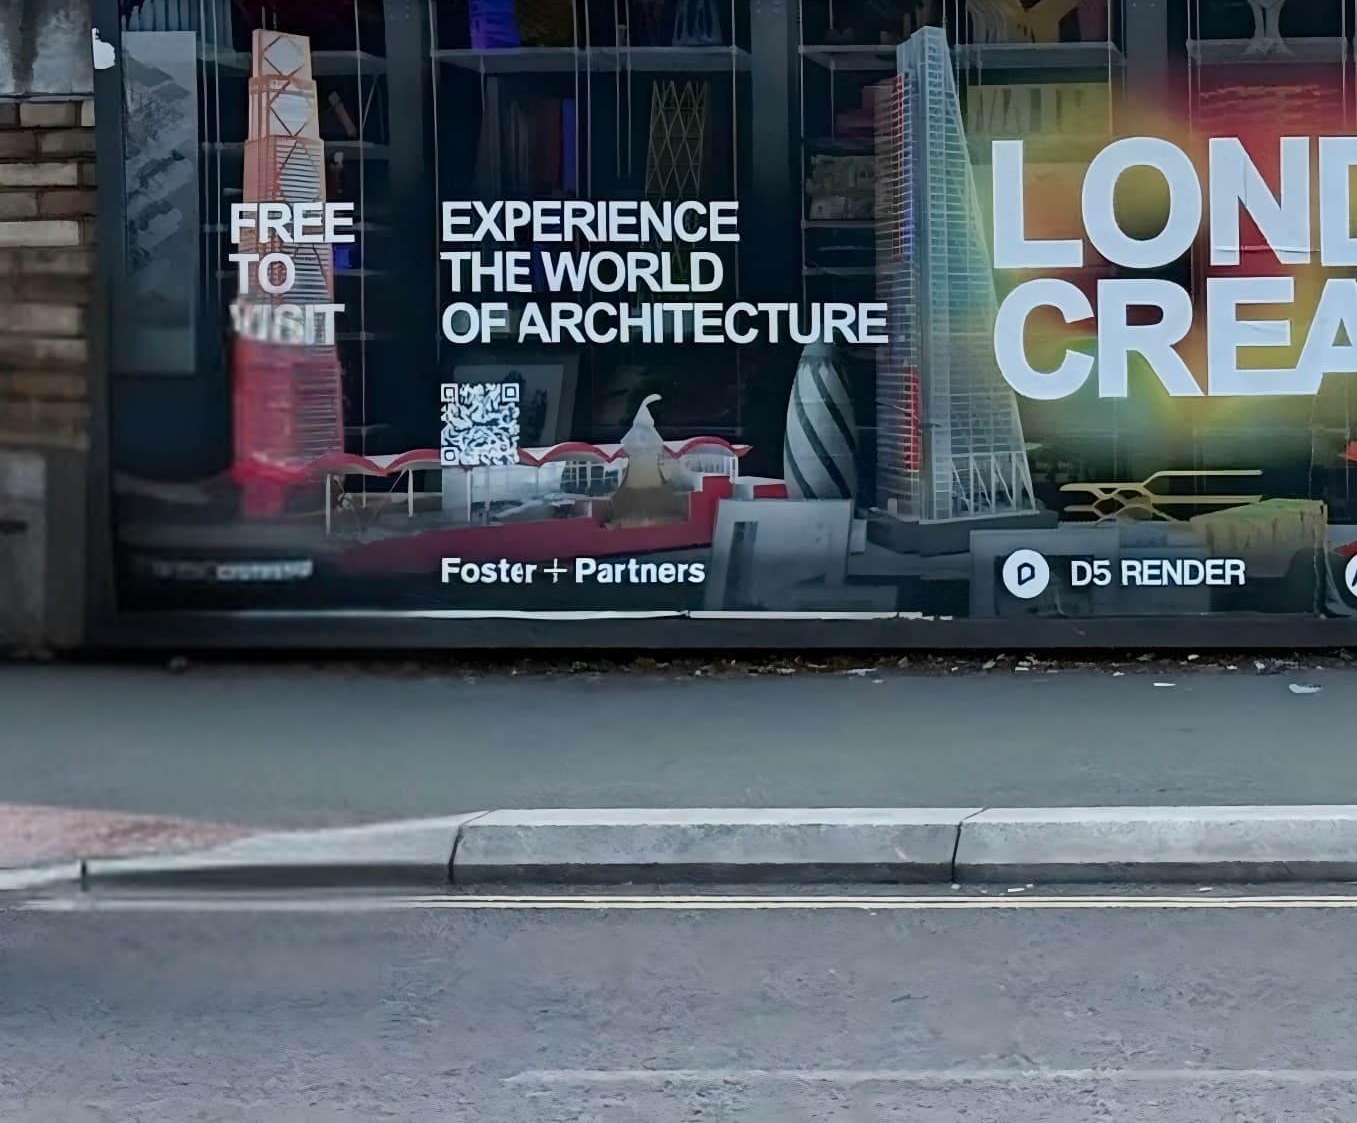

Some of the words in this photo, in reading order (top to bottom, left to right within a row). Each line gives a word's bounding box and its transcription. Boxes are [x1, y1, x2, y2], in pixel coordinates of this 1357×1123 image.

[230, 202, 355, 243] FREE
[442, 201, 740, 242] EXPERIENCE
[229, 252, 296, 294] TO
[440, 252, 532, 293] THE
[541, 252, 723, 293] WORLD
[229, 304, 345, 345] VISIT
[442, 302, 511, 344] OF
[518, 302, 889, 344] ARCHITECTURE
[441, 558, 537, 584] Foster
[575, 557, 706, 584] Partners
[1071, 560, 1112, 587] D5
[1121, 559, 1246, 586] RENDER
